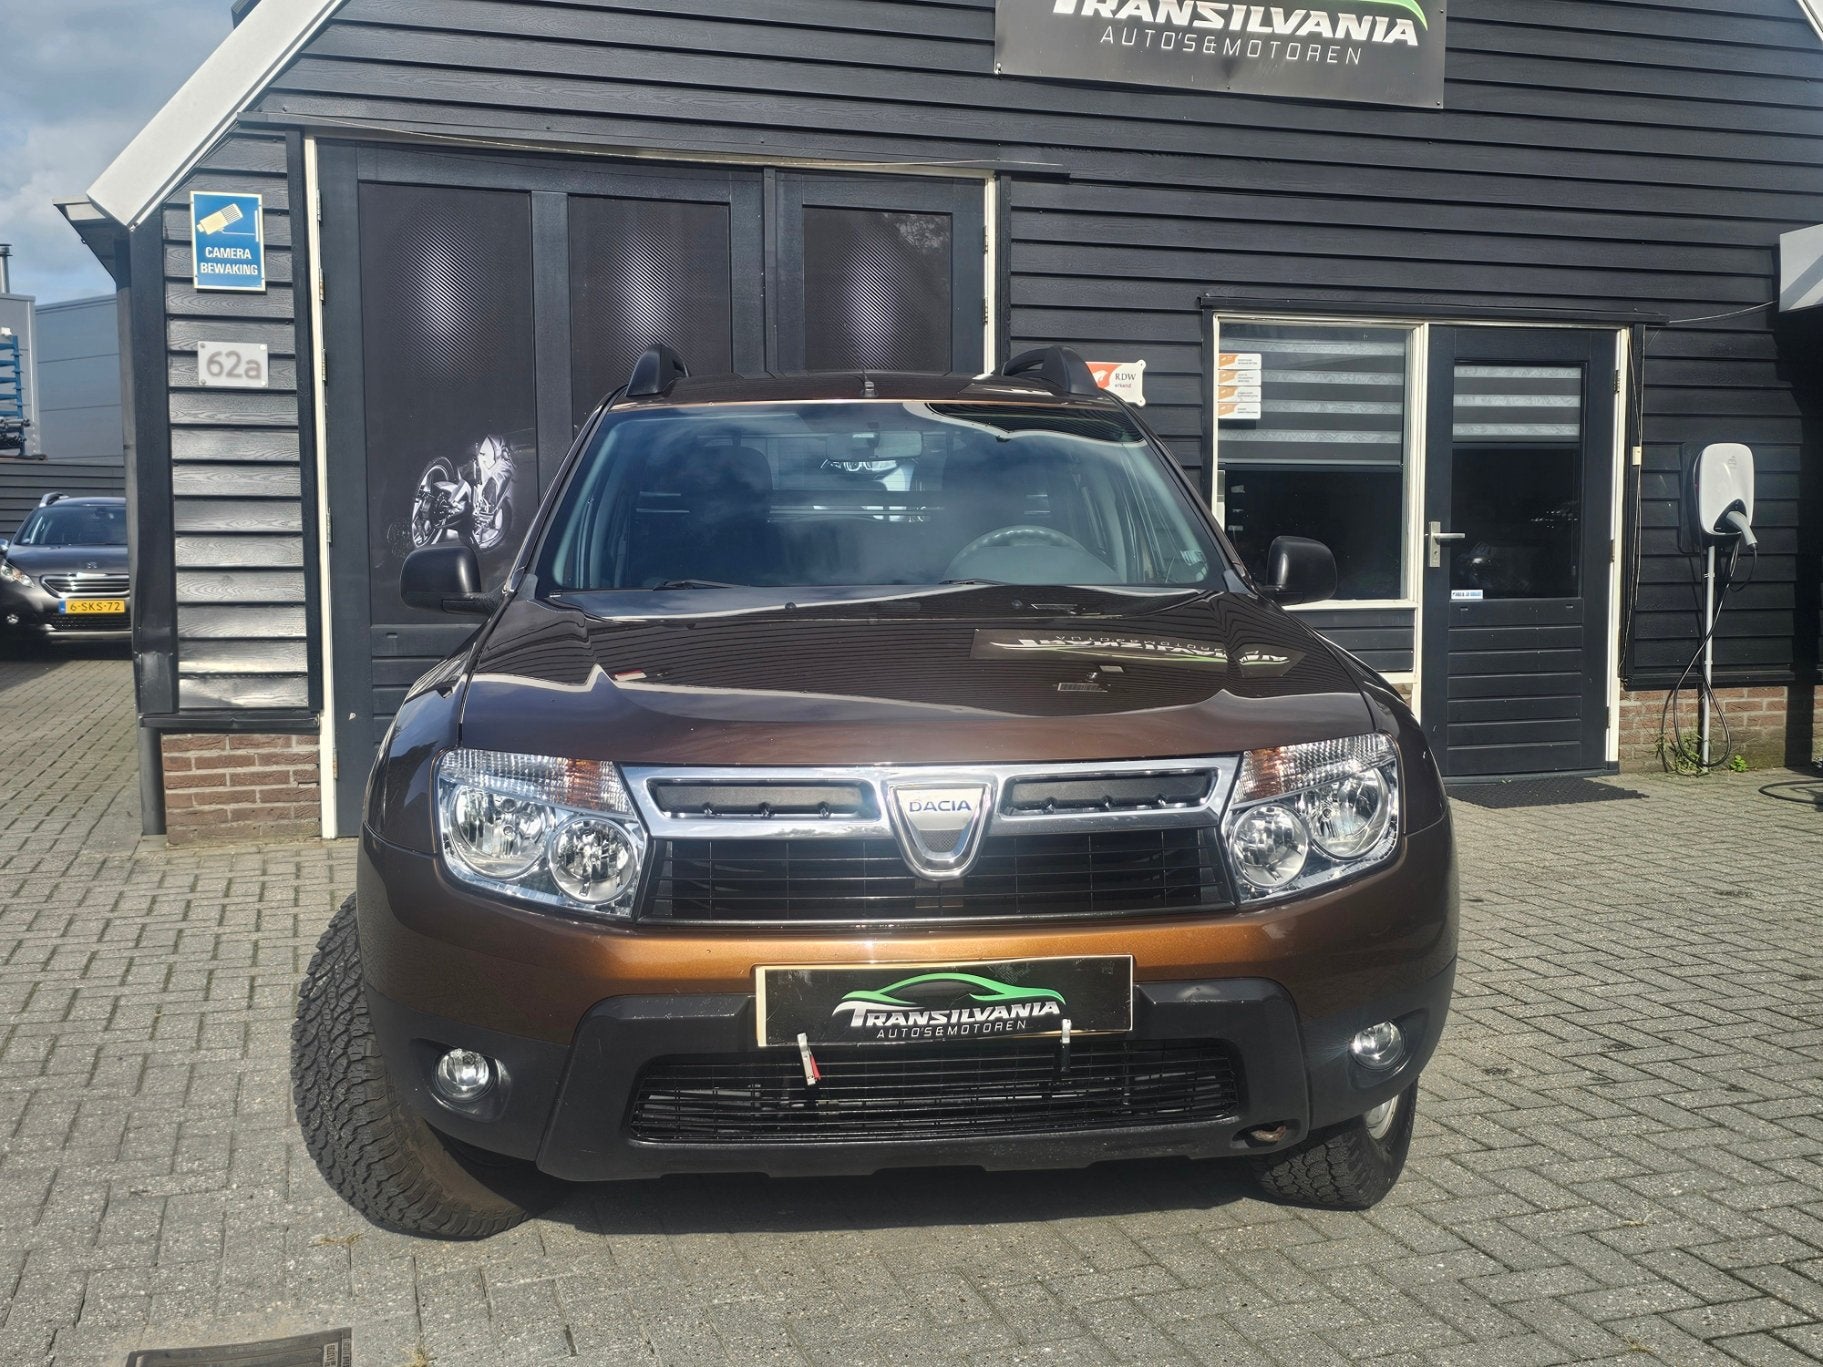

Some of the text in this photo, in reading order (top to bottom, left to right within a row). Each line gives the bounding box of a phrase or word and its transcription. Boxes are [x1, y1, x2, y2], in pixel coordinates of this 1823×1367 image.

[1100, 25, 1363, 65] AUTO'S&MOTOREN
[205, 246, 252, 260] CAMERA
[200, 262, 258, 275] BEWAKING
[206, 350, 262, 380] 62a
[1115, 373, 1136, 381] RDW
[69, 602, 121, 612] 6-SKS-72
[909, 800, 972, 812] DACIA
[832, 1000, 1061, 1027] TRANSILVANIA
[876, 1019, 1028, 1039] AUTO'S&MOTOREN
